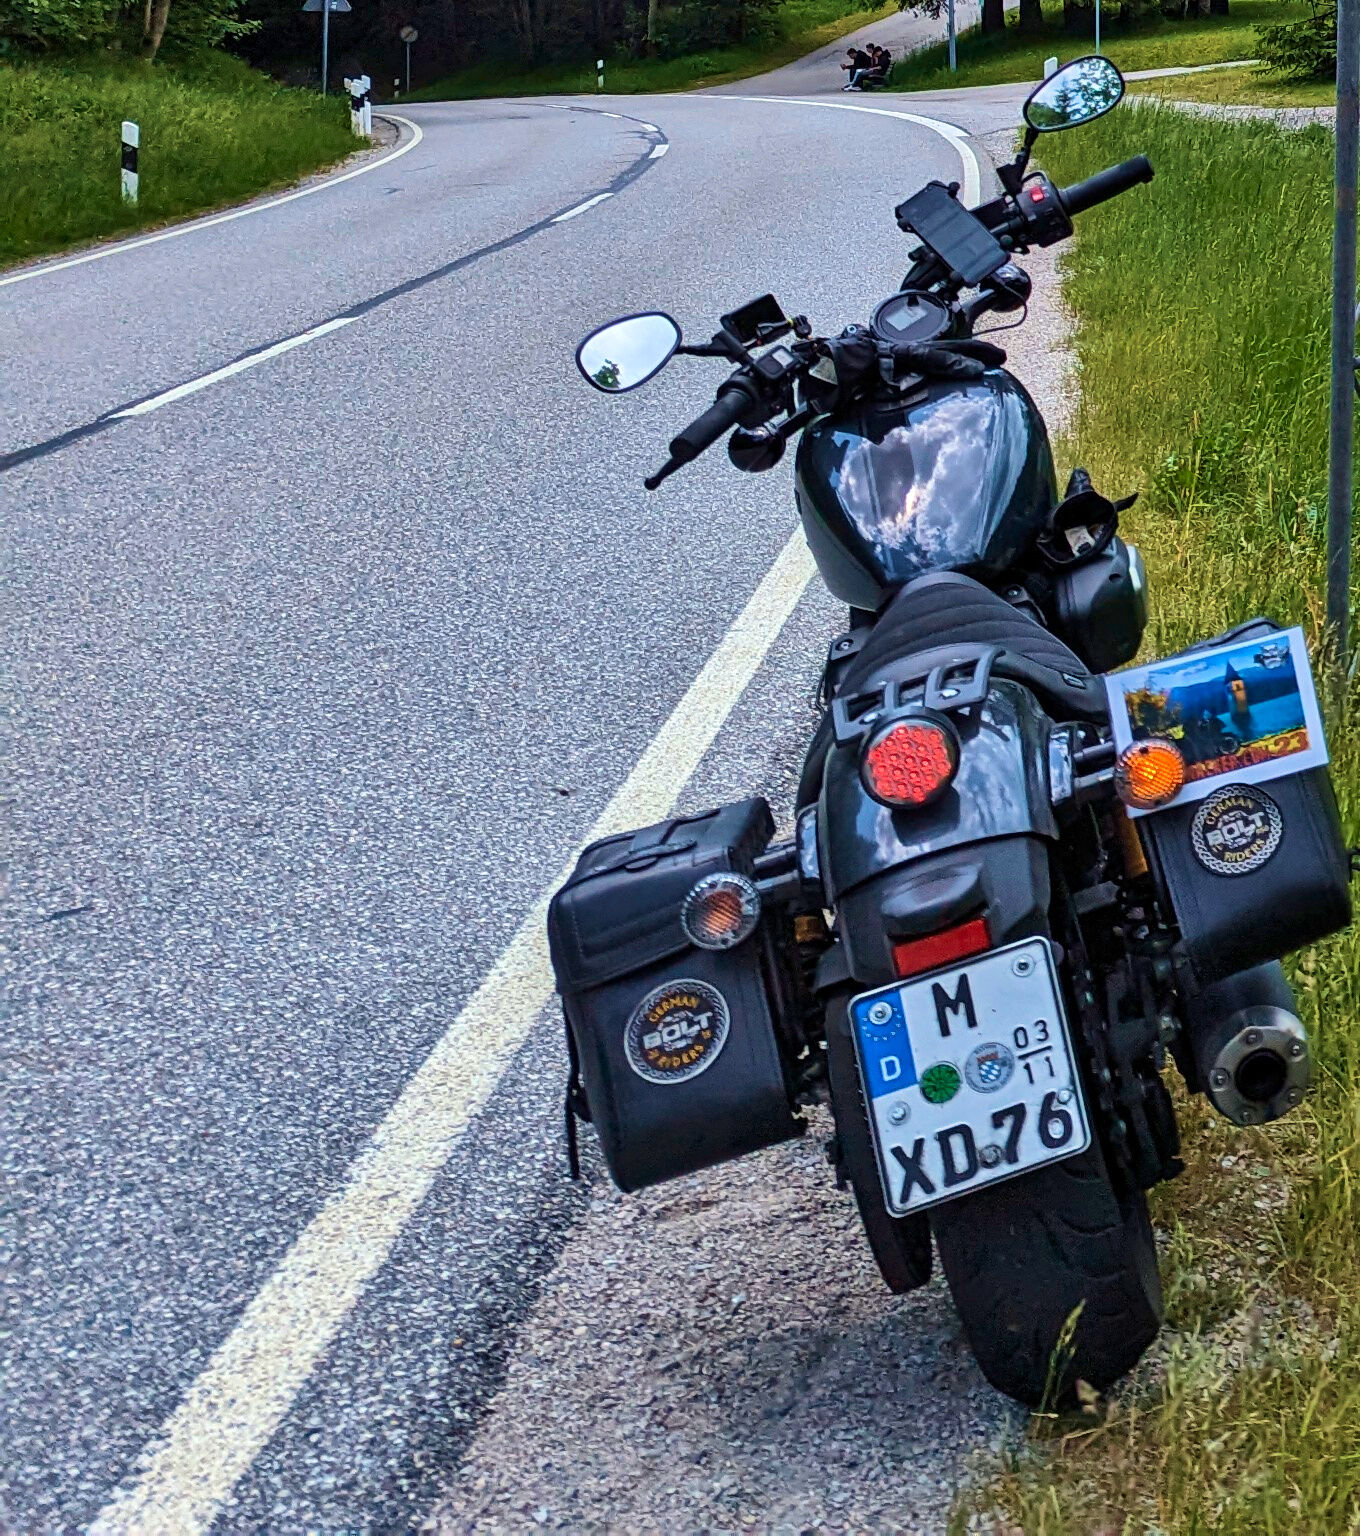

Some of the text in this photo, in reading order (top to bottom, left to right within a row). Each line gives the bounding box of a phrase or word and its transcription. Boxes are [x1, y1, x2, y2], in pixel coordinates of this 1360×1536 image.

[1205, 811, 1265, 847] BOLT
[931, 972, 978, 1038] M
[642, 1011, 714, 1050] BOLT
[1013, 1019, 1050, 1049] 03
[880, 1055, 901, 1082] D
[1023, 1055, 1056, 1085] 11
[890, 1091, 1074, 1205] XD 76
